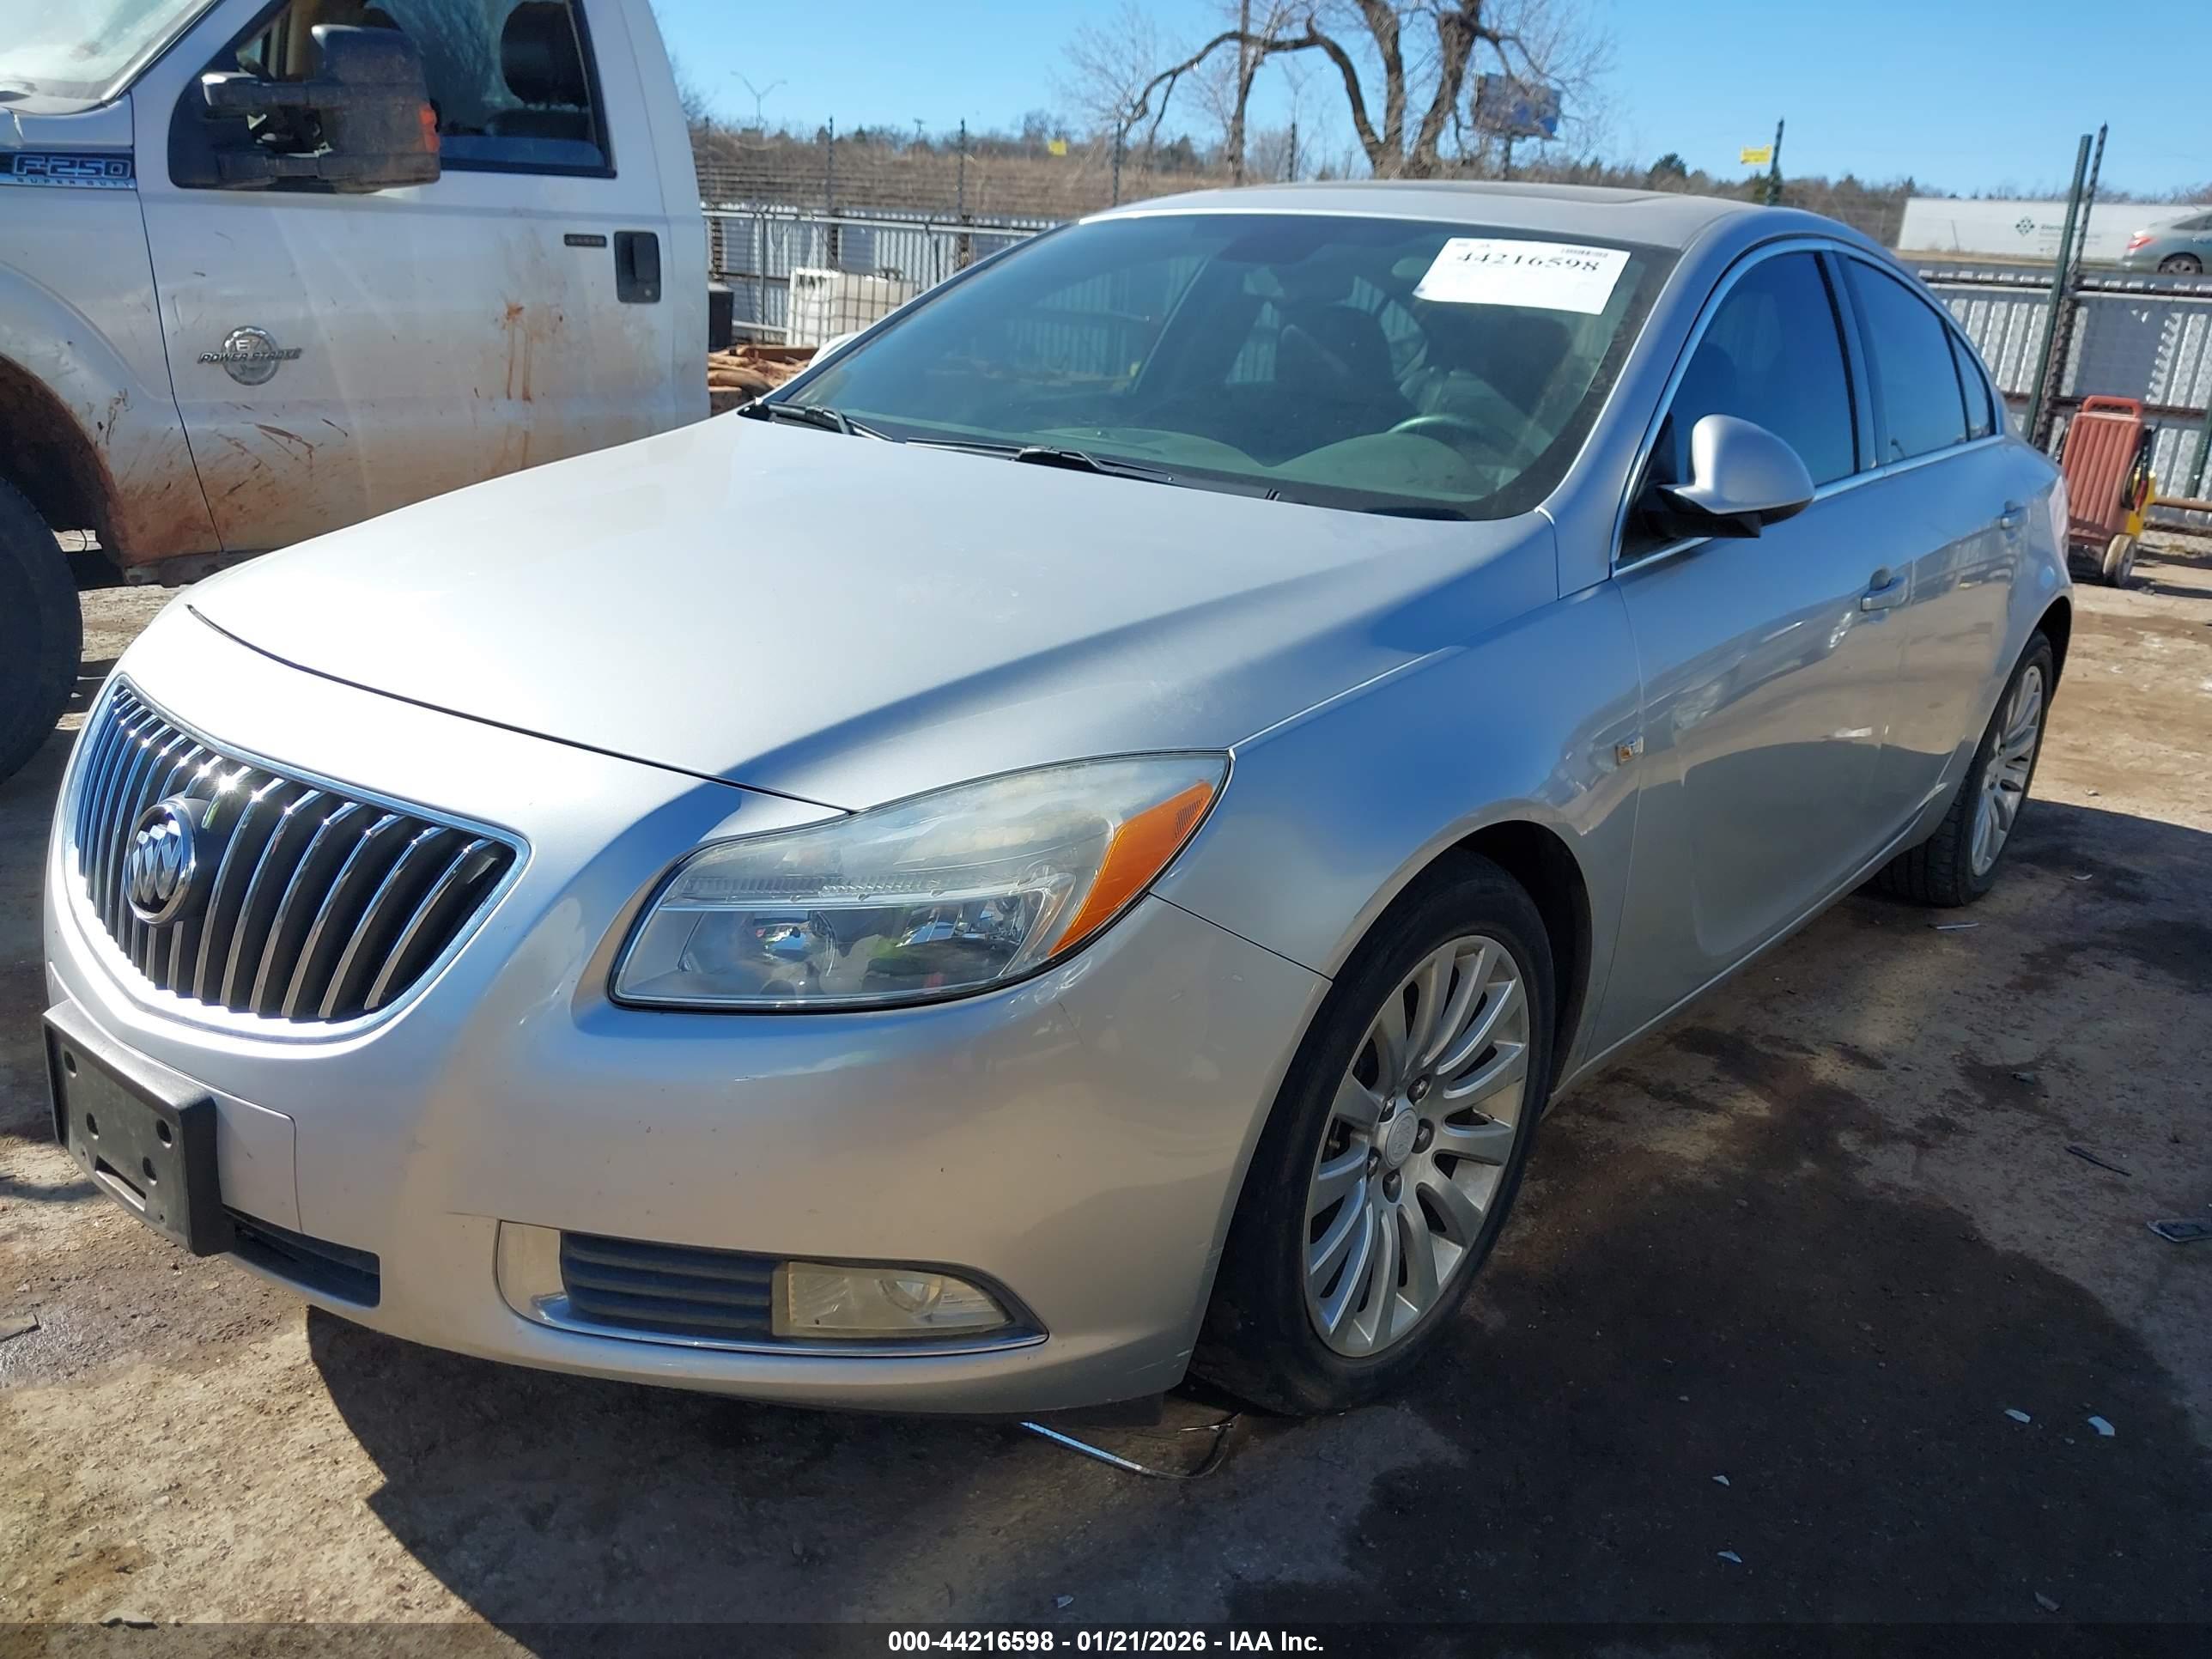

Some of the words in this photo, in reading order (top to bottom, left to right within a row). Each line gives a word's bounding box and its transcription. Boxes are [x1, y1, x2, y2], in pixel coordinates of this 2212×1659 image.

[15, 155, 131, 179] F-250
[1457, 252, 1601, 271] 44216598
[200, 352, 249, 364] POWER
[249, 348, 302, 362] STROKE
